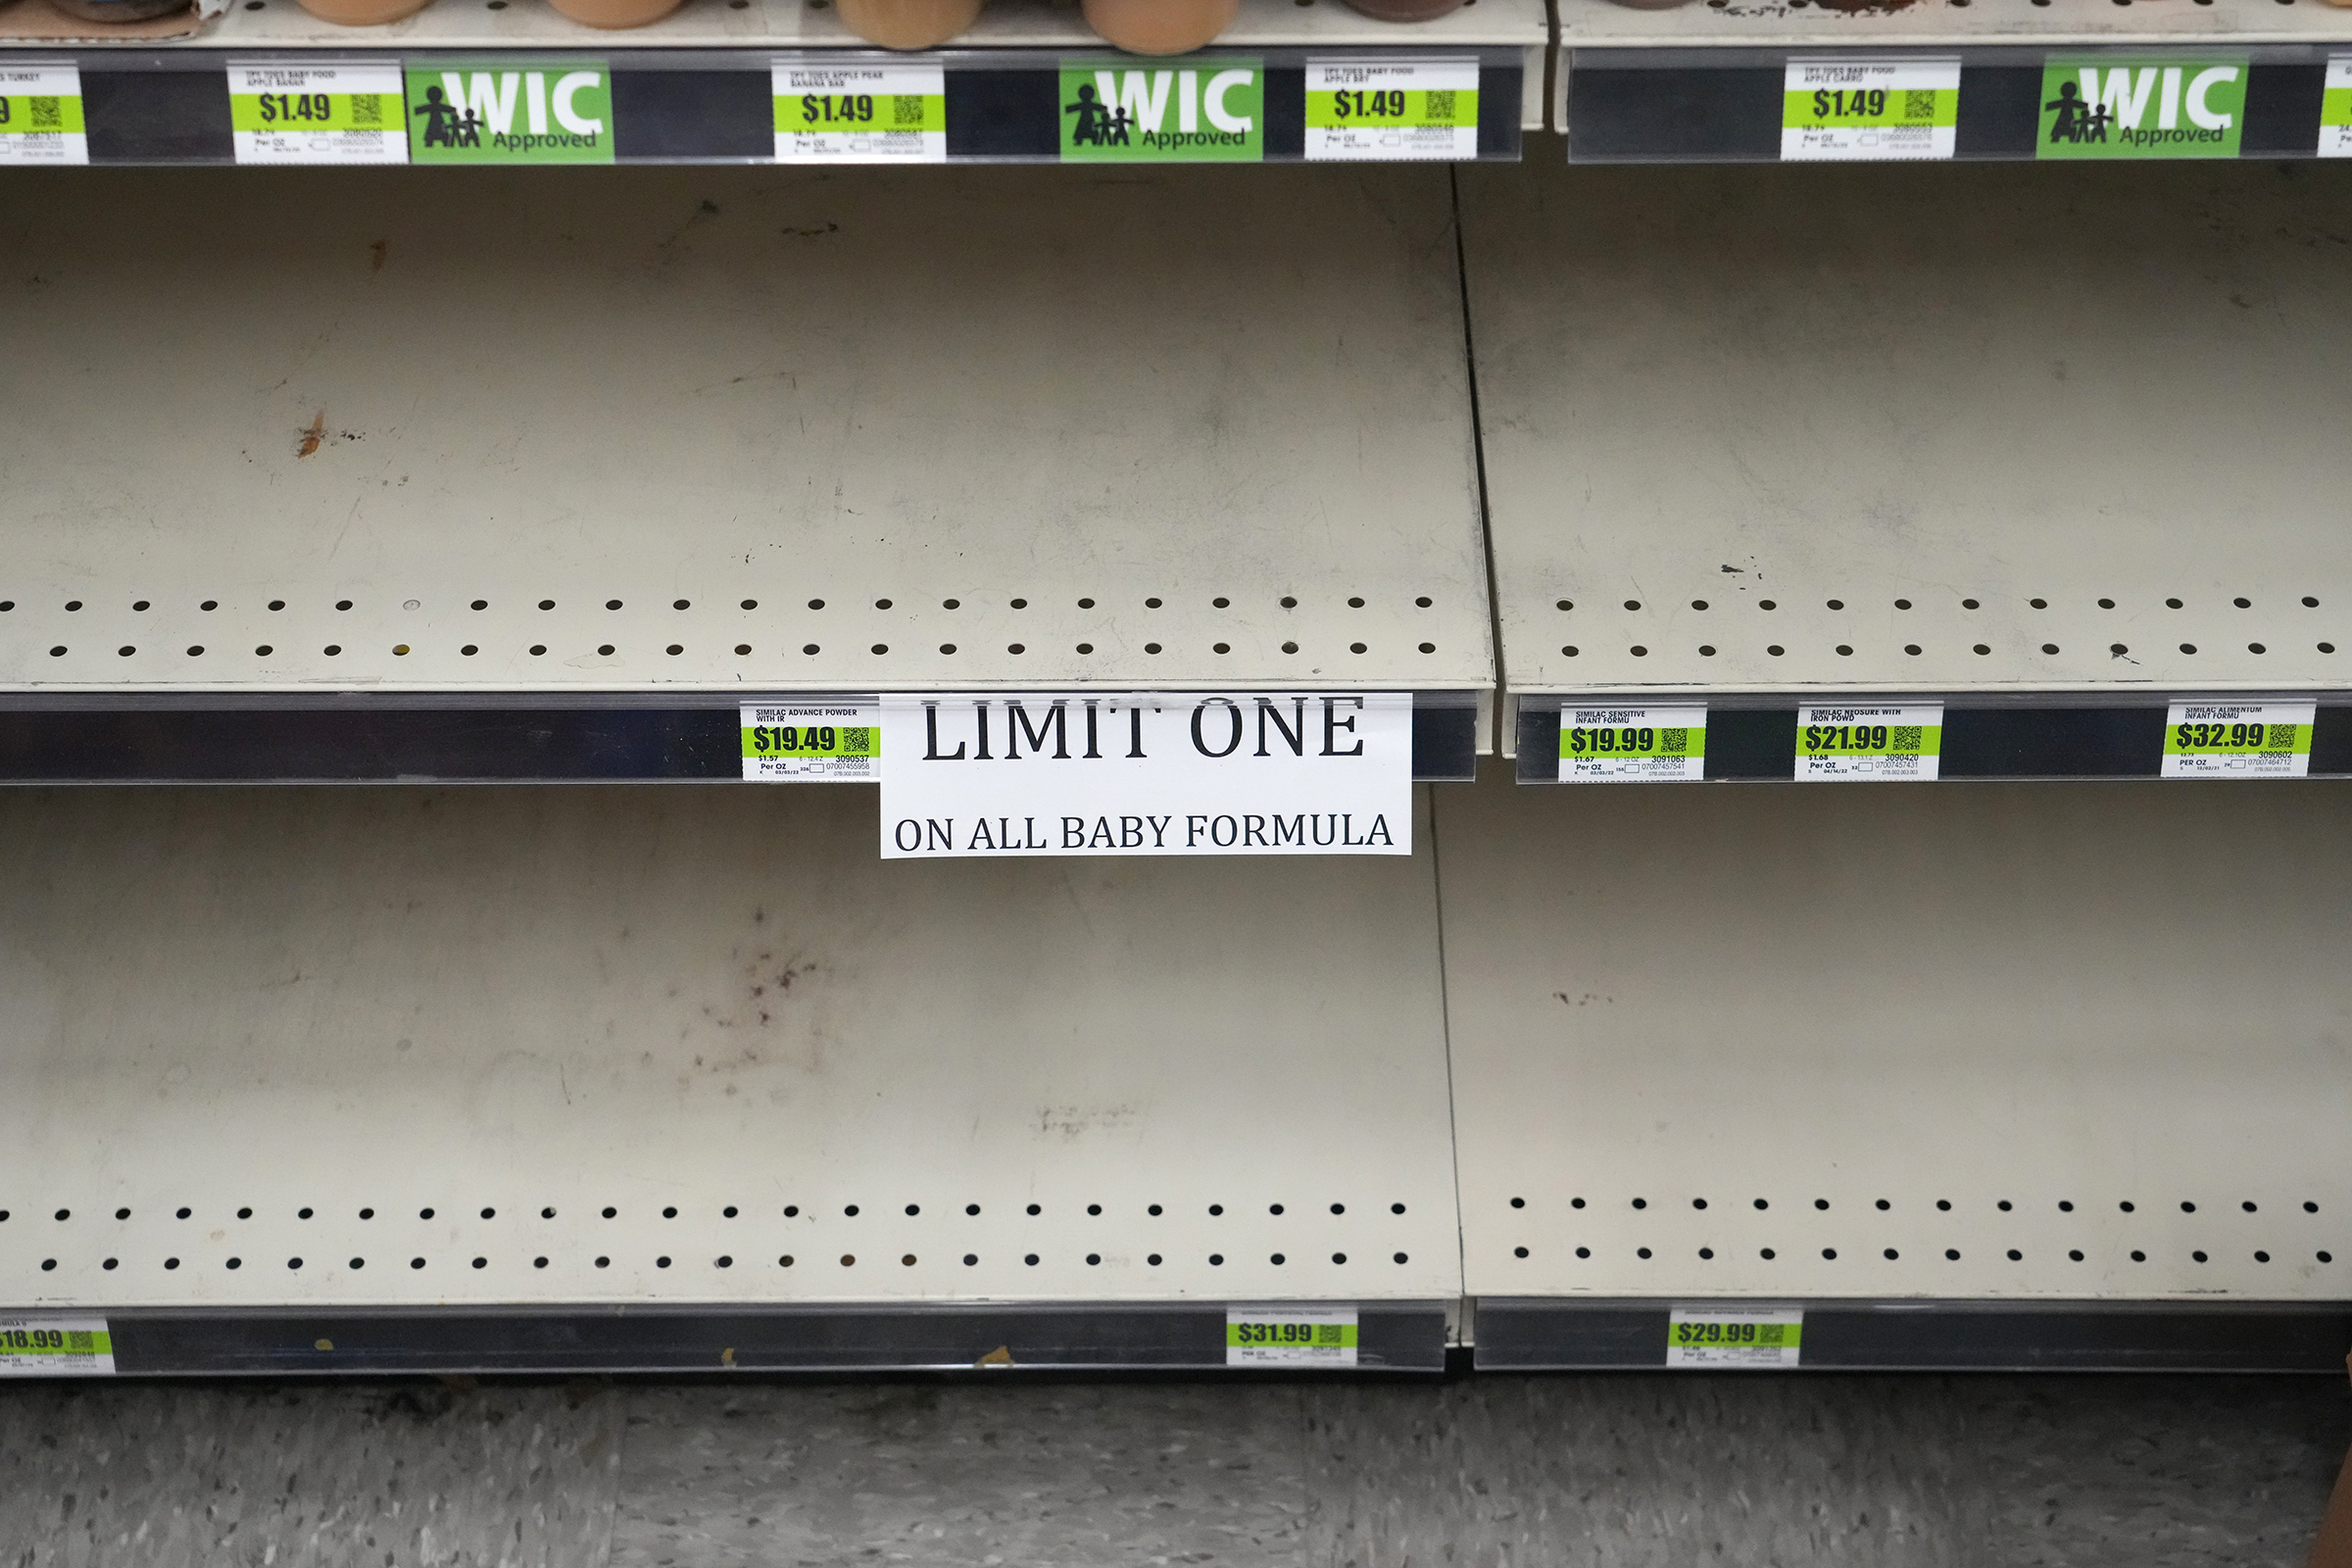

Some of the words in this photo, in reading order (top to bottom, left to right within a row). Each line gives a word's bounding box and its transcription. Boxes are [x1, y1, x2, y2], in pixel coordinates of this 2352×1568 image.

[260, 92, 330, 122] $1.49
[441, 72, 604, 135] WIC
[803, 93, 873, 123] $1.49
[1094, 70, 1253, 132] WIC
[1335, 89, 1404, 120] $1.49
[1814, 88, 1885, 118] $1.49
[2079, 67, 2239, 130] WIC
[493, 129, 596, 152] Approved
[1143, 127, 1245, 150] Approved
[2120, 124, 2224, 147] Approved
[754, 725, 835, 753] $19.49
[920, 696, 1161, 760] LIMIT
[1190, 696, 1365, 760] ONE
[1571, 727, 1653, 753] $19.99
[1806, 724, 1887, 752] $21.99
[2177, 722, 2264, 749] $32.99
[895, 813, 954, 852] ON
[967, 813, 1047, 852] ALL
[1061, 813, 1172, 852] BABY
[1185, 813, 1395, 852] FORMULA
[1239, 1323, 1311, 1343] $31.99
[1679, 1322, 1755, 1343] $29.99
